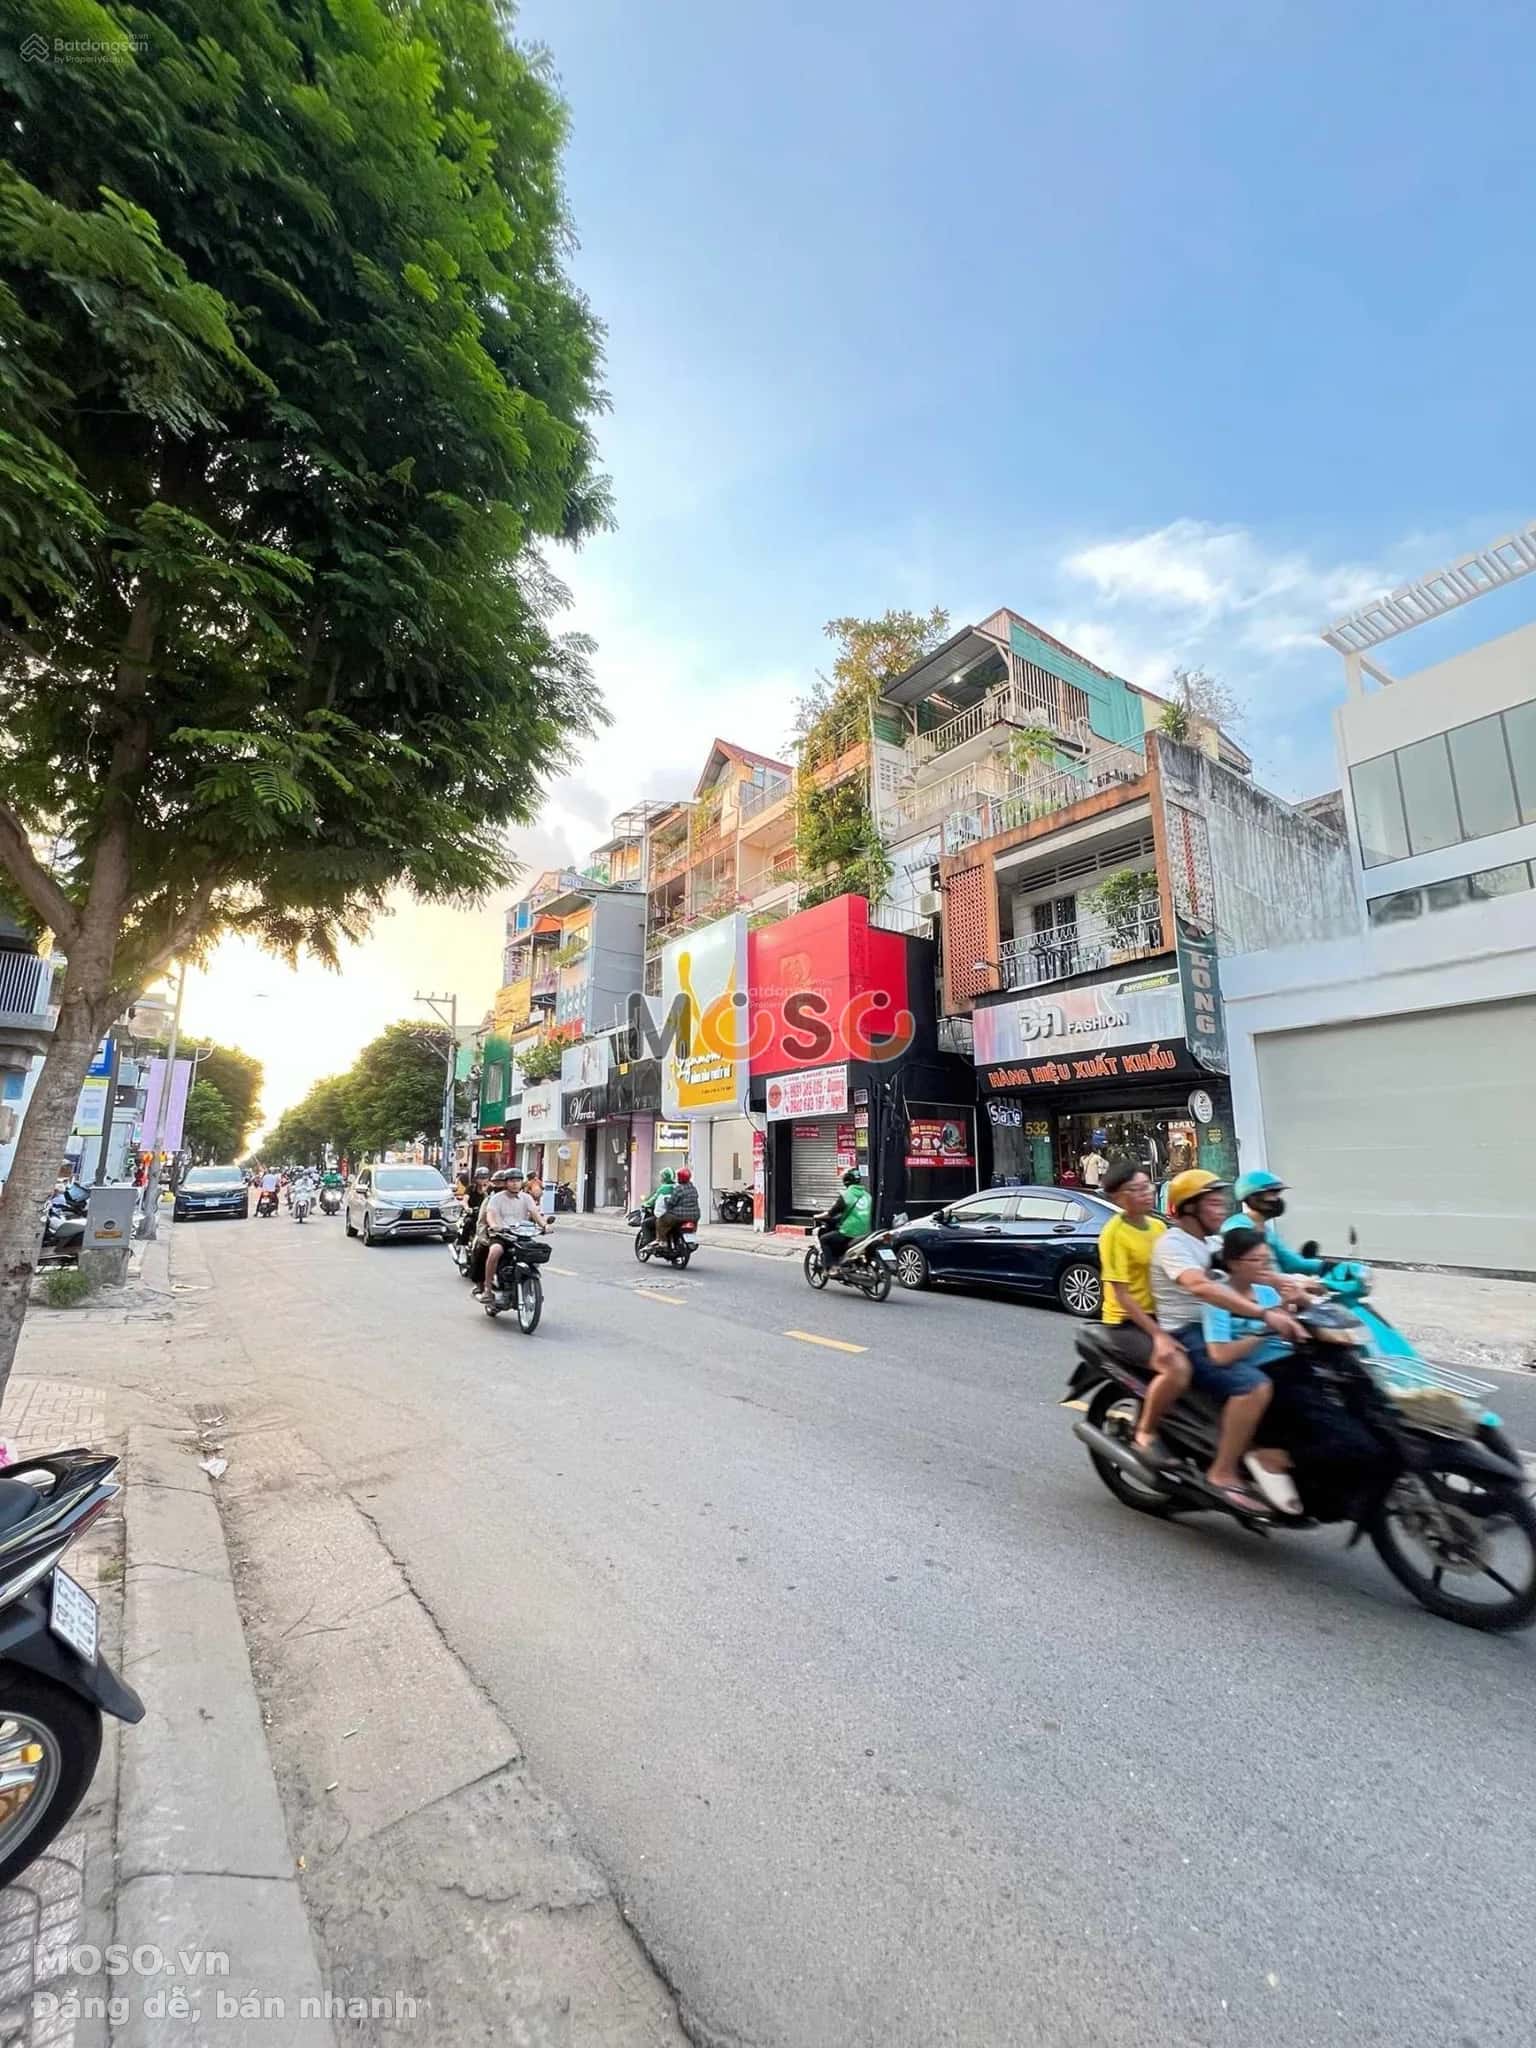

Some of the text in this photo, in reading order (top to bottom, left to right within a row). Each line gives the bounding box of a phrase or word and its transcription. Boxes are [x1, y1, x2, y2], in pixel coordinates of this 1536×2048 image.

[1067, 1011, 1129, 1035] FASHION
[988, 1066, 1031, 1088] HÀNG
[1031, 1060, 1071, 1085] HIỆU
[1073, 1051, 1118, 1080] XUẤT
[1122, 1043, 1177, 1074] KHẨU
[1024, 1121, 1049, 1136] 532
